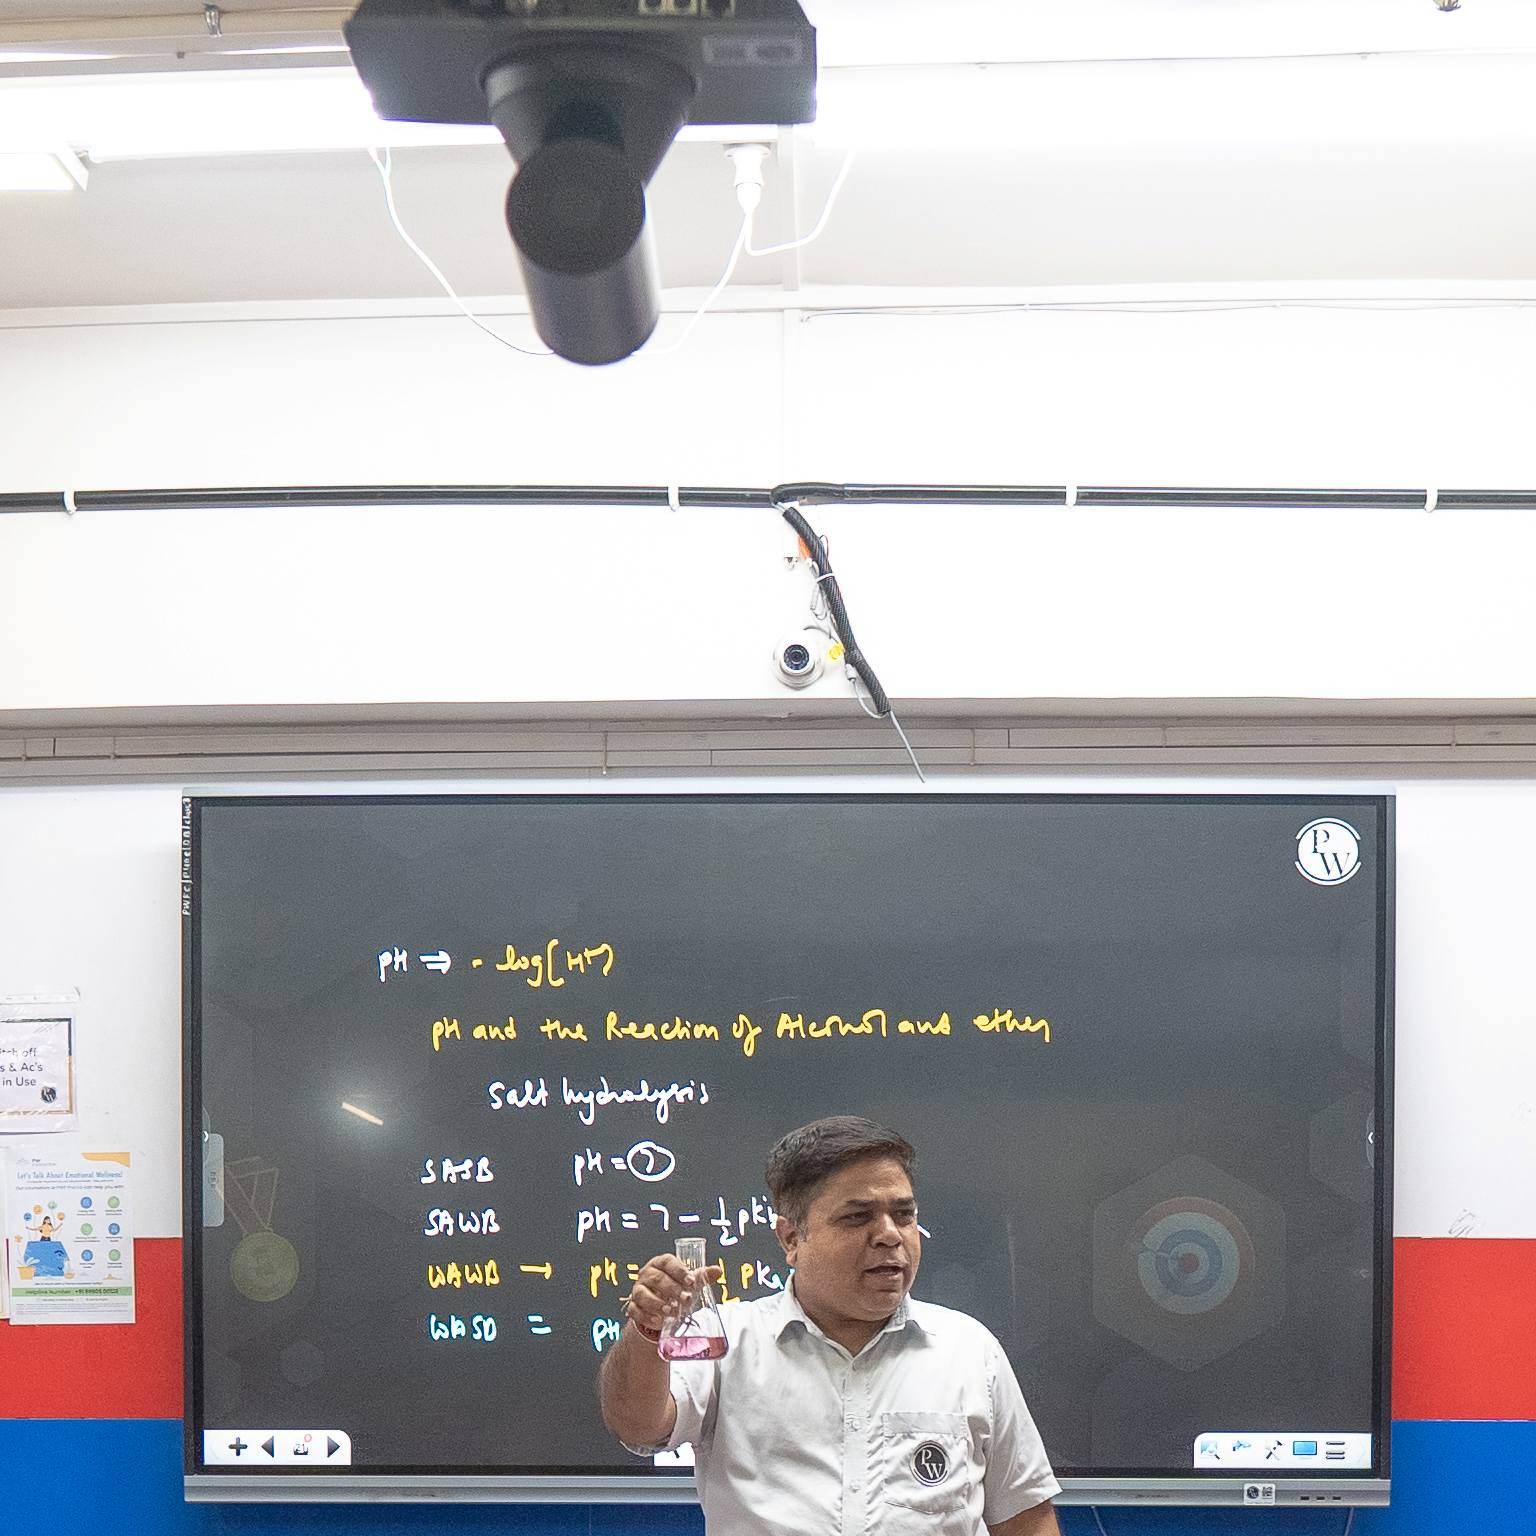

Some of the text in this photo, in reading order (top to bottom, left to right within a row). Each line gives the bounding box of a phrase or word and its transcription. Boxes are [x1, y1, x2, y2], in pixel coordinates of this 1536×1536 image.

[1312, 828, 1351, 877] PW
[472, 1016, 517, 1041] and
[539, 1018, 588, 1042] the
[606, 1011, 719, 1041] Reaction
[2, 1077, 12, 1087] in
[15, 1076, 37, 1087] Use
[488, 1077, 549, 1110] Salt
